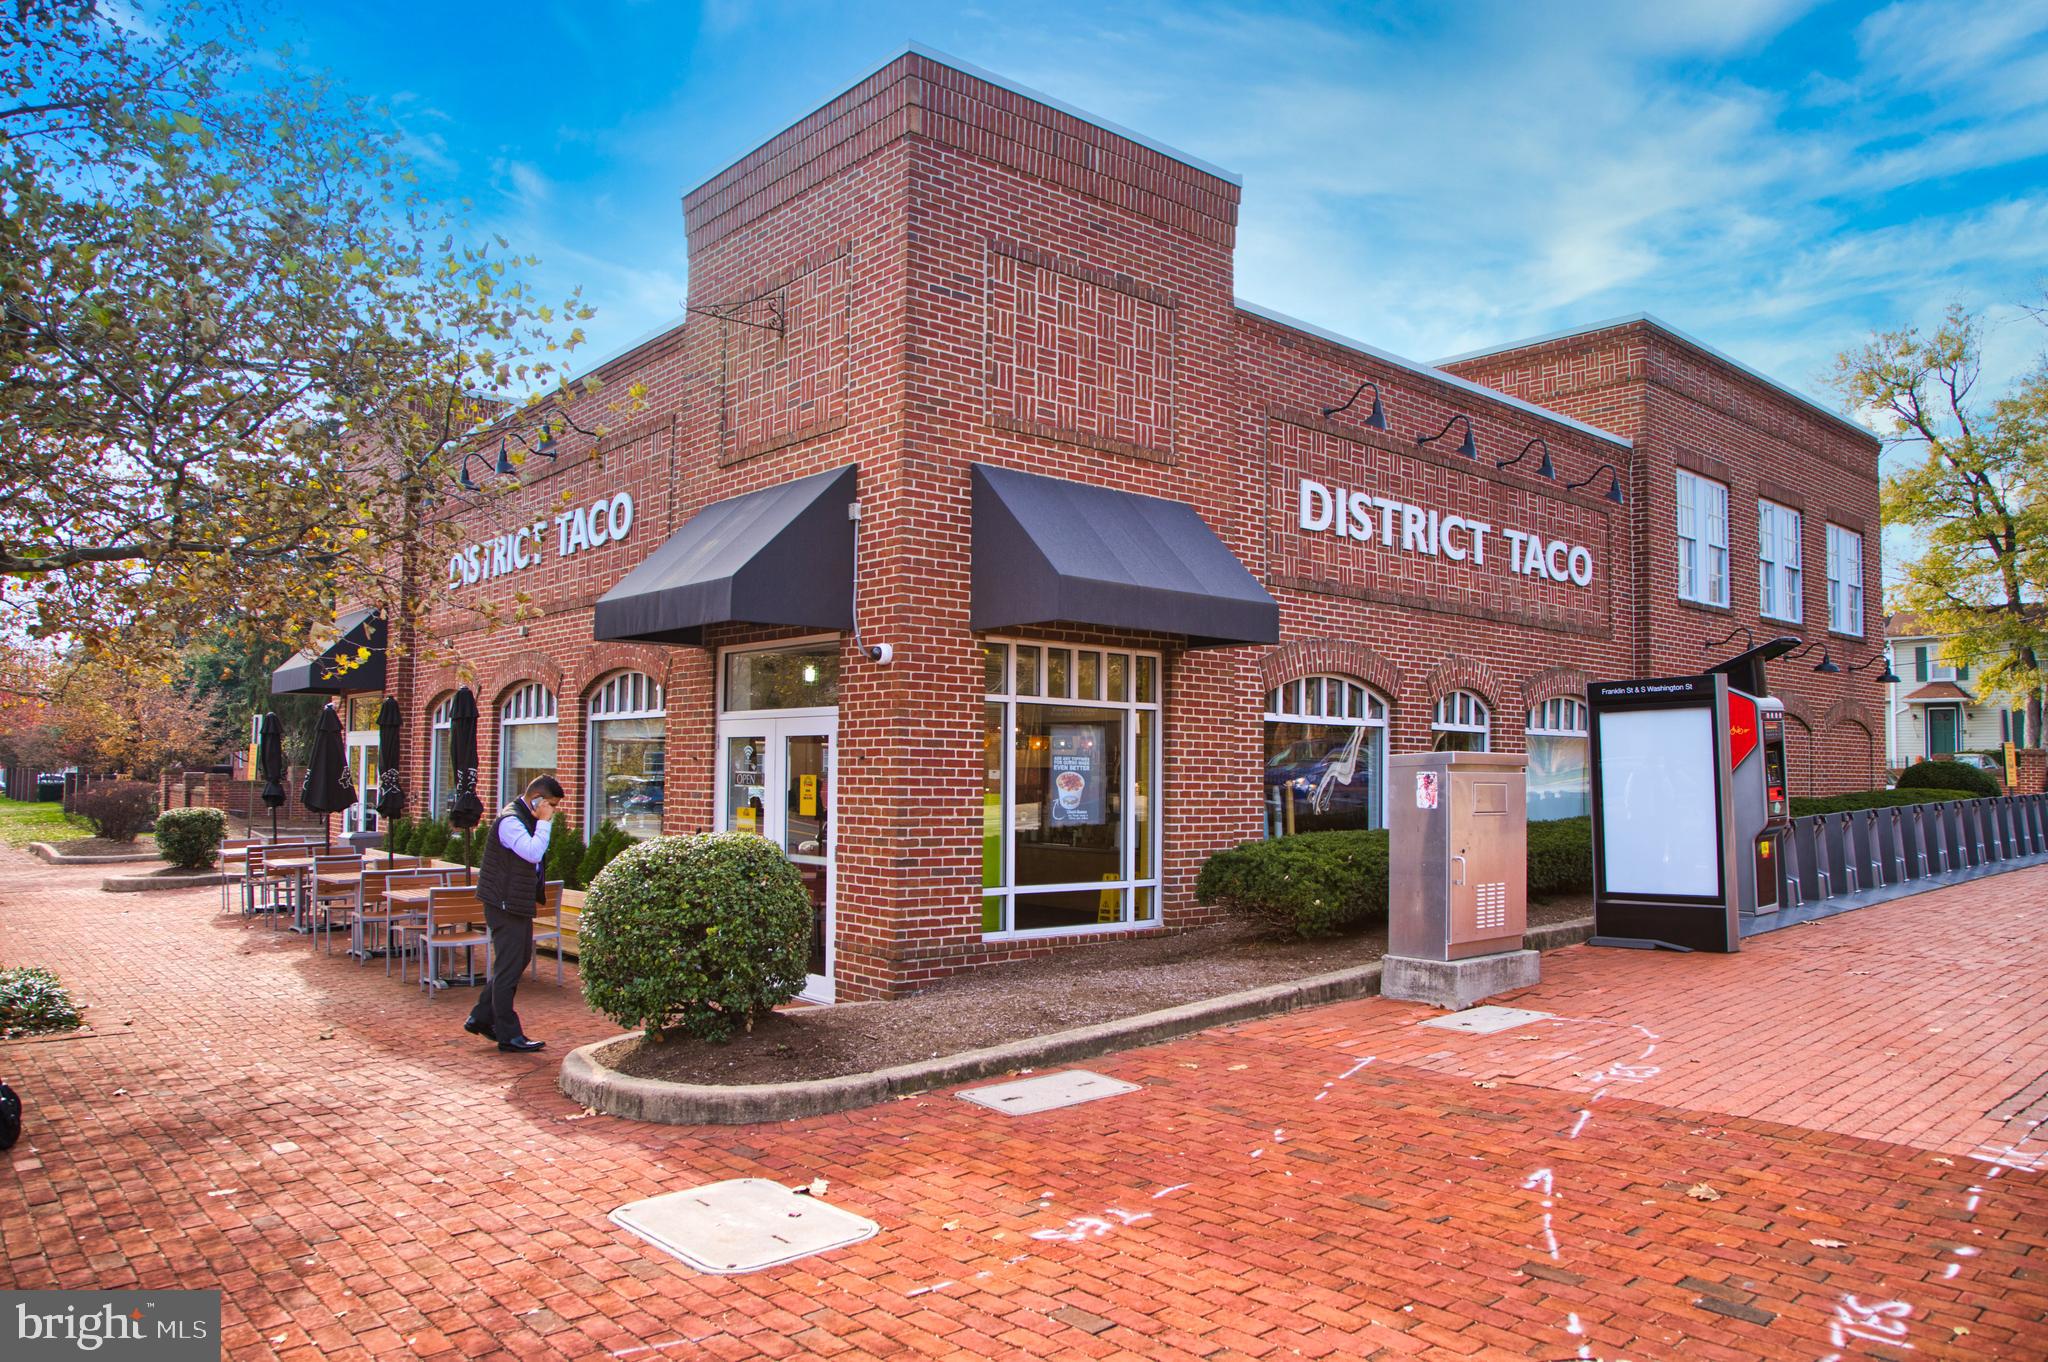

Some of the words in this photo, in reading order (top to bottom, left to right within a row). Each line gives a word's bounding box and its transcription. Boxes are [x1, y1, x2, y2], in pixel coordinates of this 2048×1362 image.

[449, 520, 548, 590] DISTRICT
[555, 492, 635, 558] TACO
[1299, 478, 1491, 566] DISTRICT
[1503, 528, 1593, 588] TACO
[1647, 685, 1684, 693] Washington
[736, 774, 756, 785] OPEN
